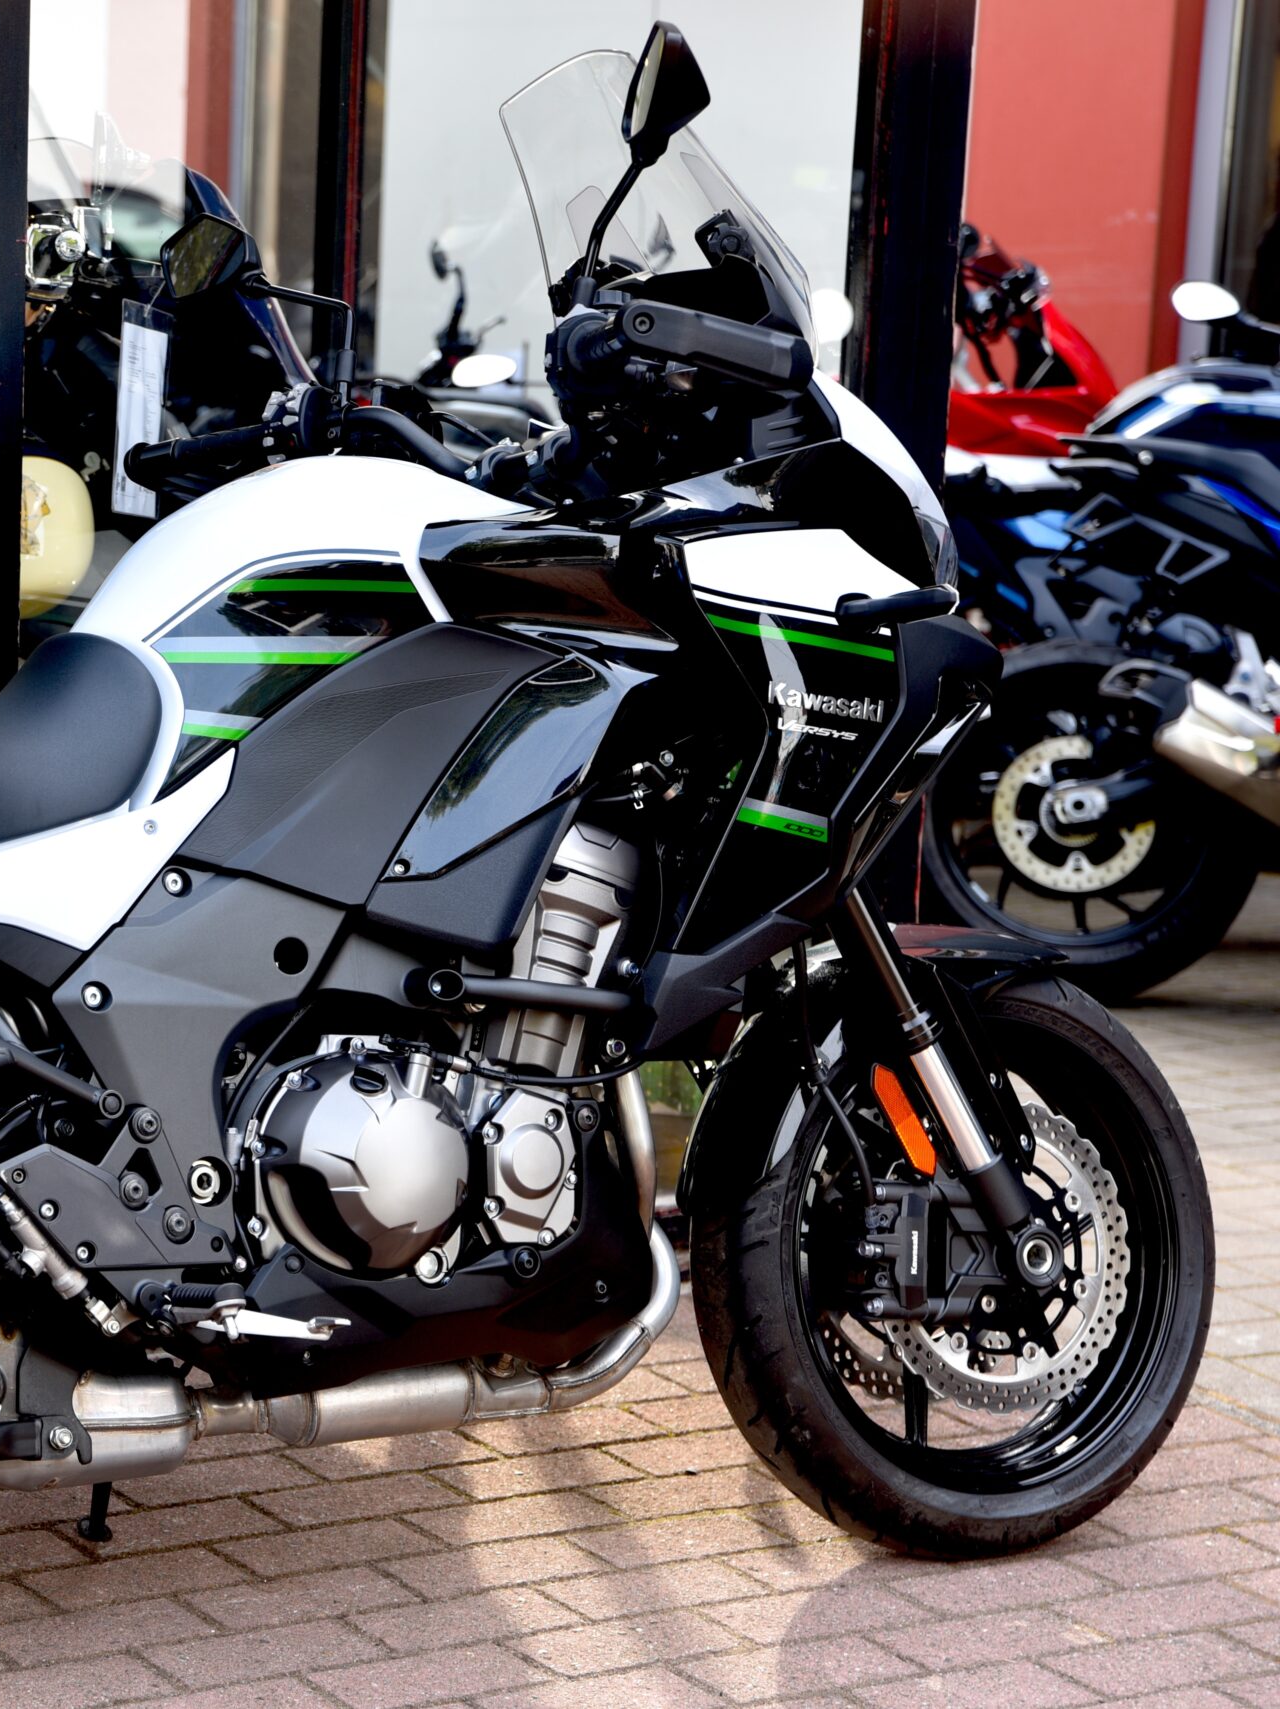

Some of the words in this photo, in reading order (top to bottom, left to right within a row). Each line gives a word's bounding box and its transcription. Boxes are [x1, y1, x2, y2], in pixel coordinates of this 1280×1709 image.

[768, 680, 884, 723] Kawasaki
[777, 717, 858, 741] VERSYS
[910, 1230, 919, 1275] Kawasaki
